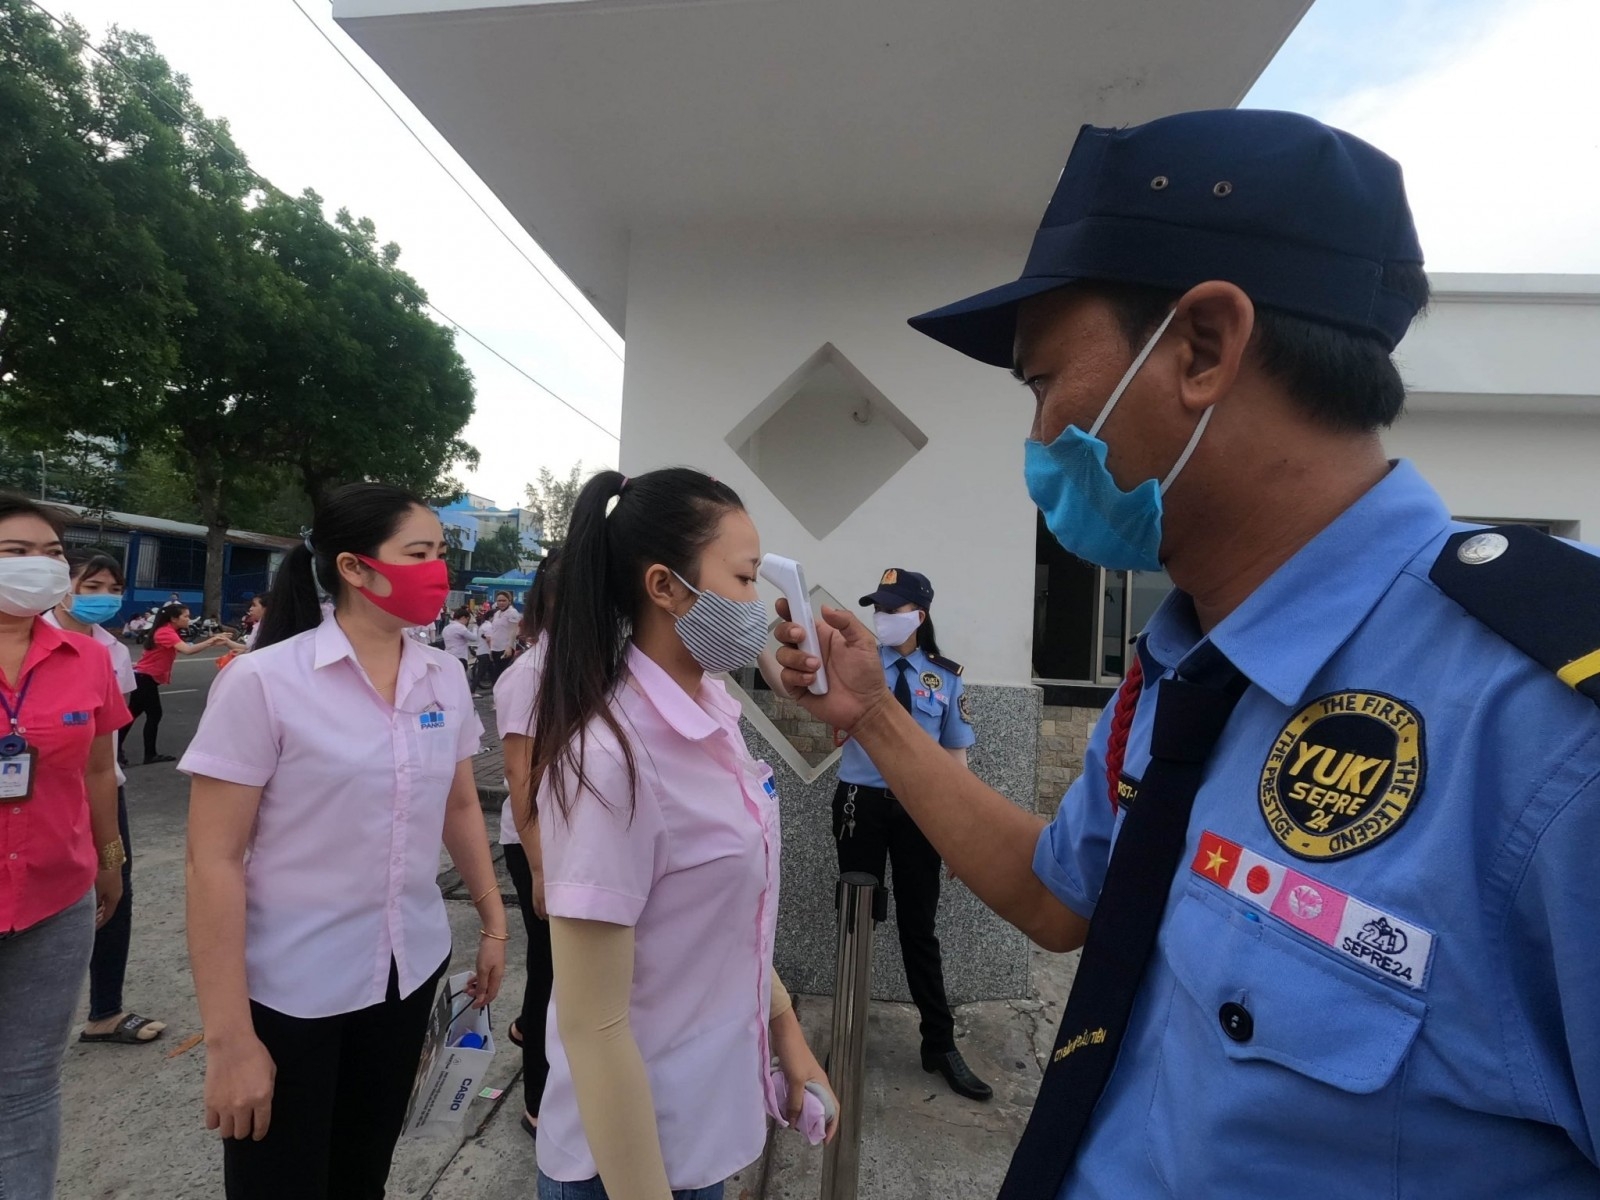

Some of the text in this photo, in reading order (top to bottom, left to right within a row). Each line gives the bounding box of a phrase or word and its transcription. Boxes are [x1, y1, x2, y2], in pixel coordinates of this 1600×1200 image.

[1319, 694, 1416, 731] THE FIRST
[1260, 730, 1298, 840] THE PRESTIGE
[1288, 741, 1391, 796] YUKI
[1288, 781, 1367, 816] SEPRE
[1329, 755, 1418, 852] THE LEGEND
[1304, 809, 1335, 832] 24
[1342, 936, 1412, 981] SEPRE24
[450, 1078, 472, 1111] CASIO
